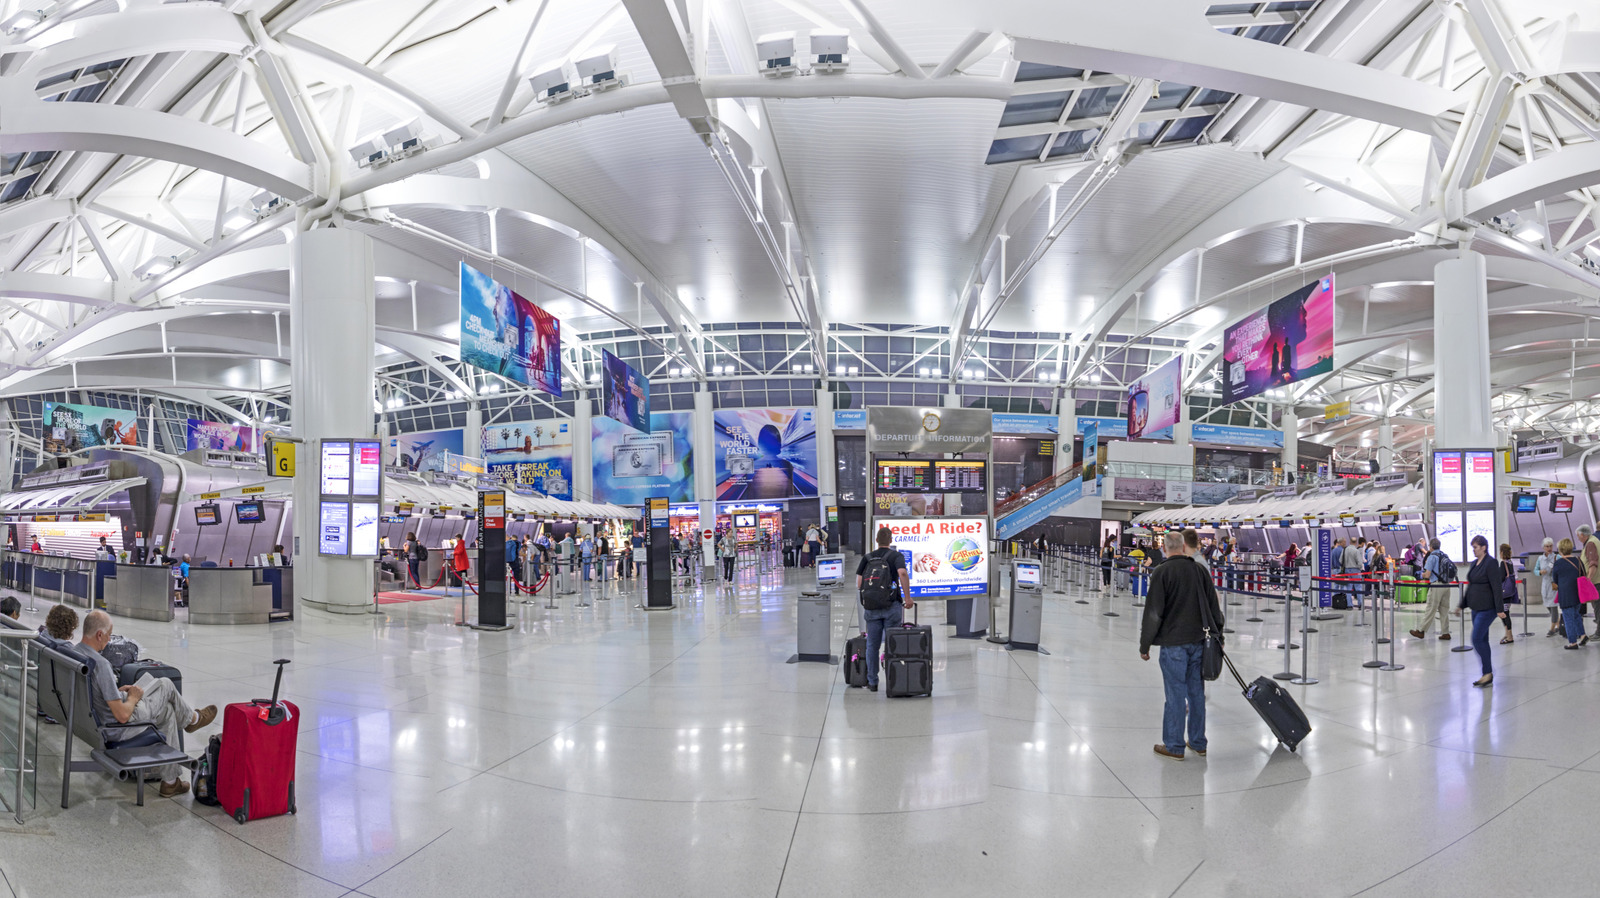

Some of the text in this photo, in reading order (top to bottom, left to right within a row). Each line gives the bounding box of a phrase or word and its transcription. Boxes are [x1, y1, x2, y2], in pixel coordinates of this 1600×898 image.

[1237, 313, 1267, 337] EXPERIENCE
[1243, 333, 1264, 350] RETHINK
[474, 340, 482, 350] TO
[499, 350, 511, 360] OUT
[1242, 350, 1259, 363] OTHER
[67, 423, 87, 431] WORLD
[726, 426, 742, 434] SEE
[734, 433, 750, 441] THE
[929, 434, 985, 443] INFORMATION
[720, 440, 750, 449] WORLD
[727, 447, 758, 457] FASTER
[280, 457, 288, 472] G
[460, 461, 484, 473] Lufthansa
[492, 464, 513, 473] TAKE
[549, 468, 562, 477] ON
[879, 522, 983, 535] Need A Ride?
[895, 535, 920, 543] CARMEL
[952, 549, 984, 561] CARMEL
